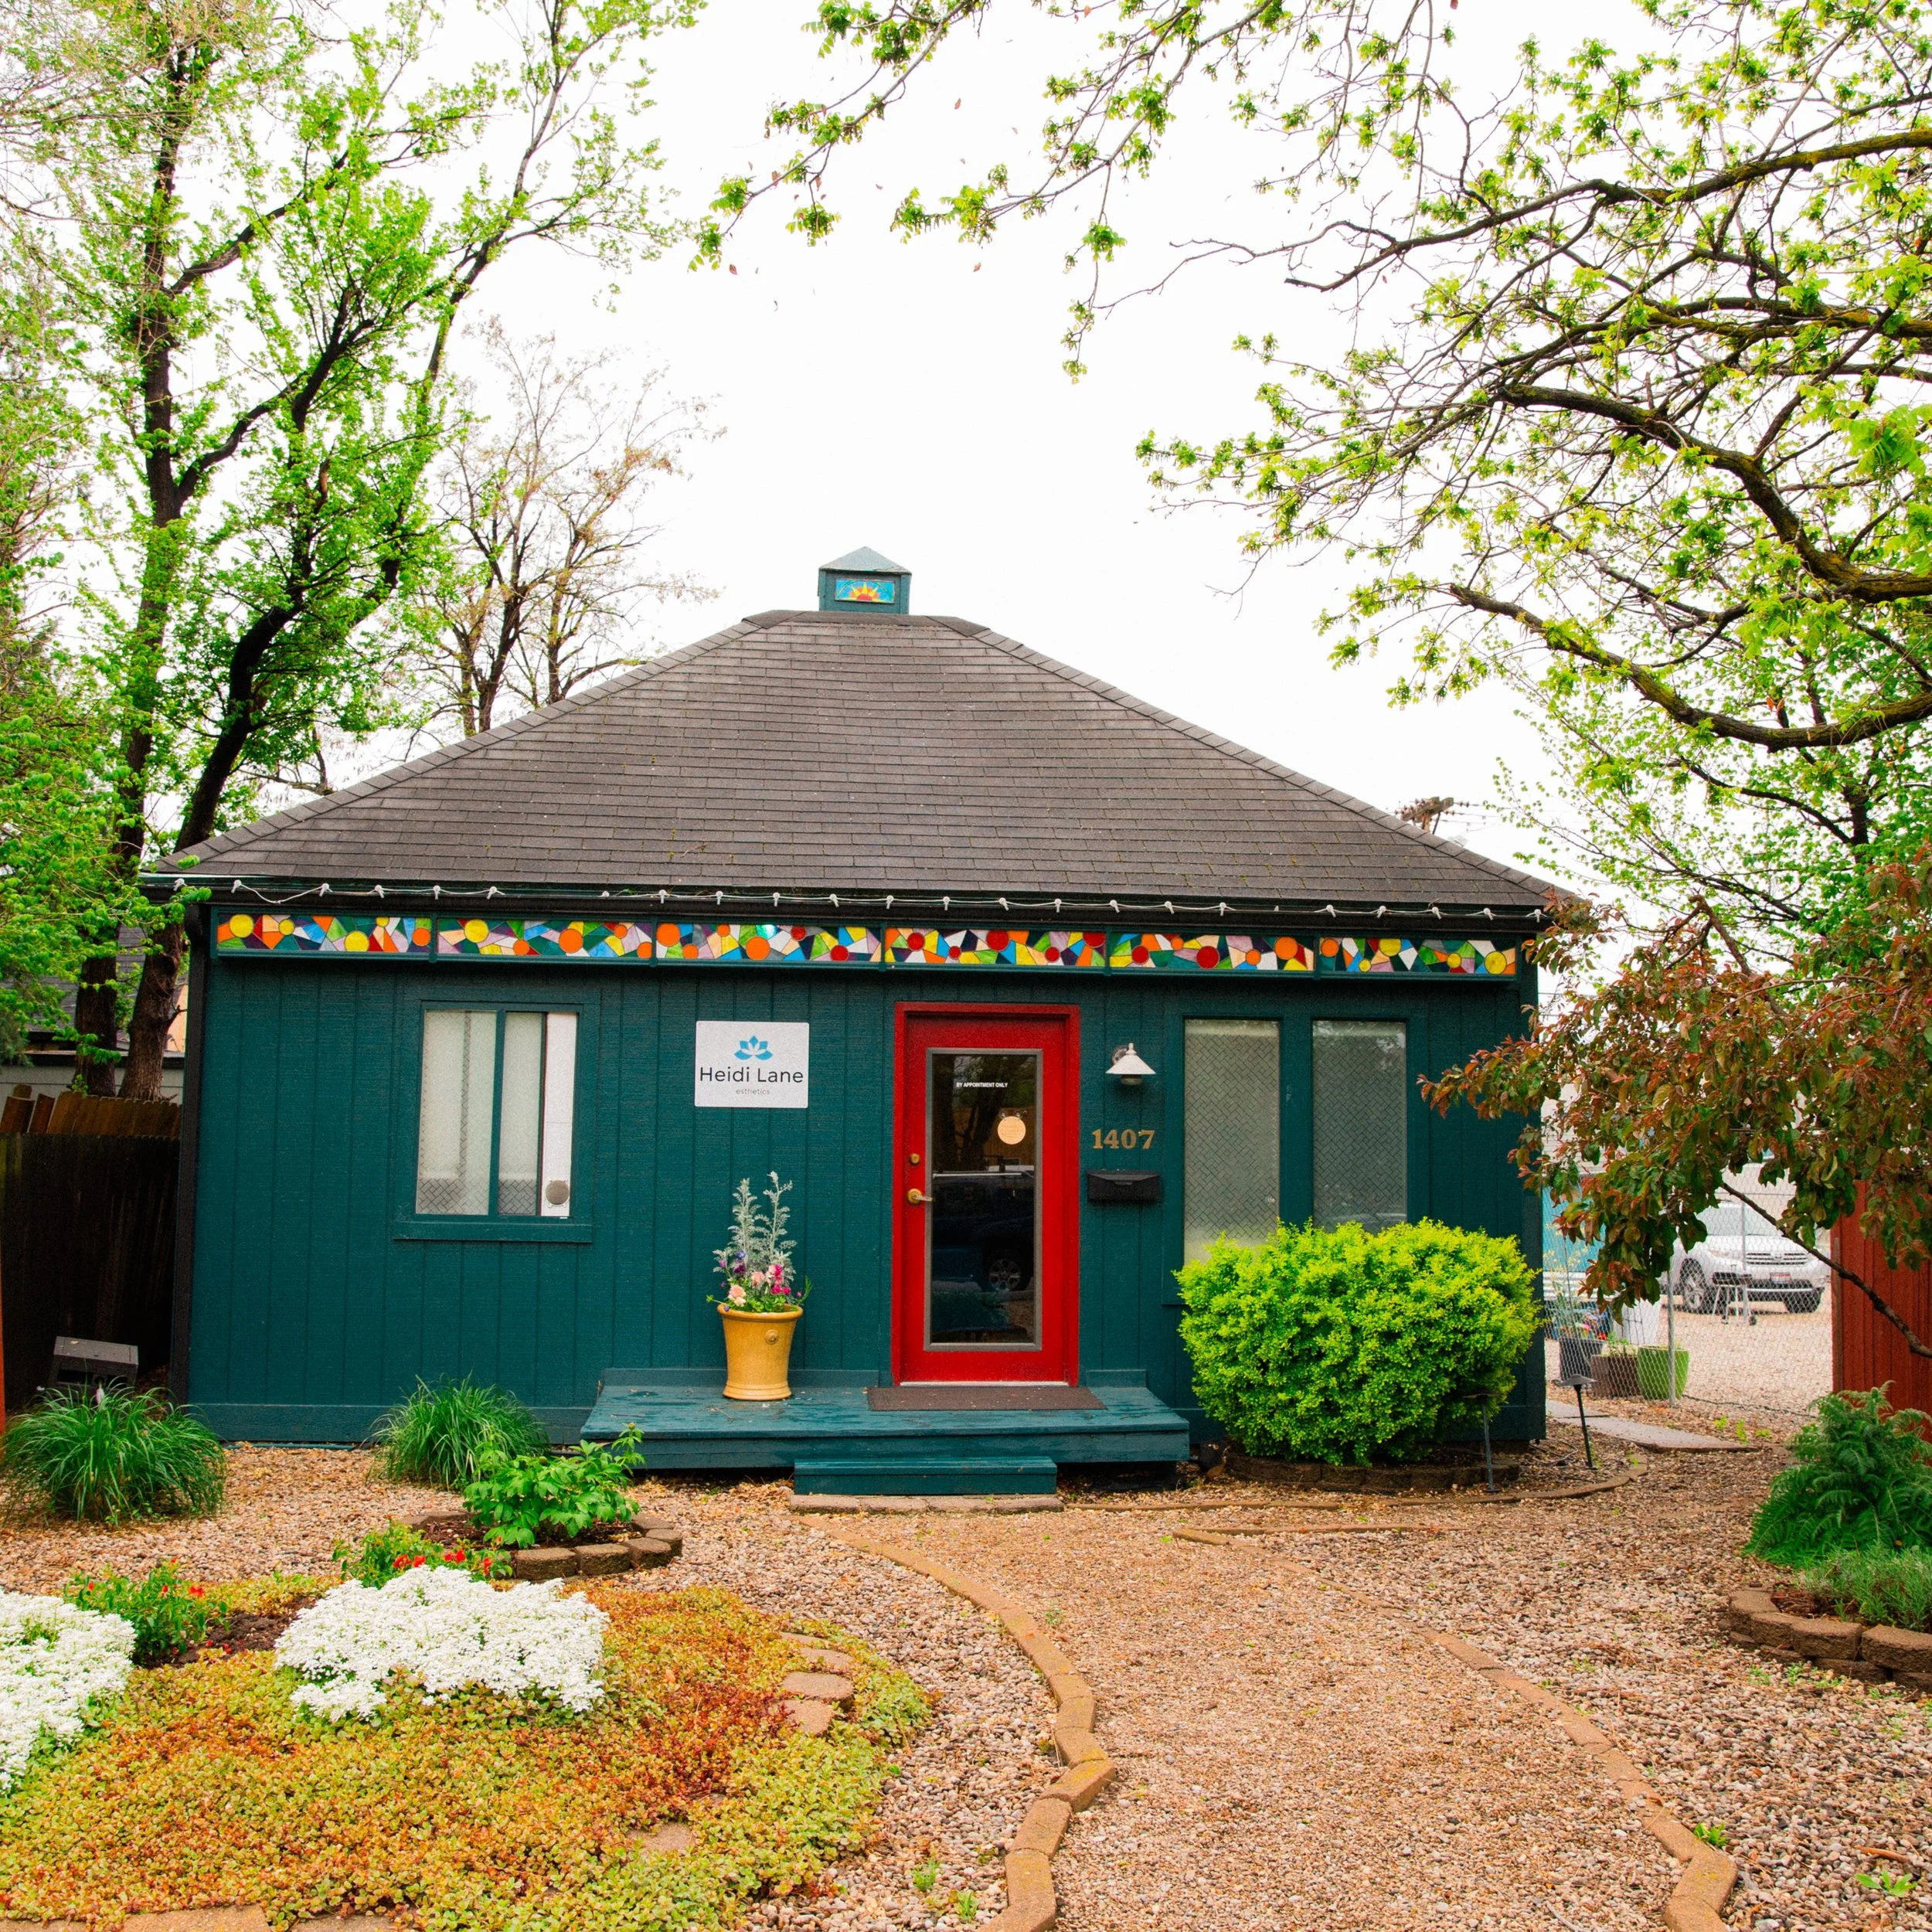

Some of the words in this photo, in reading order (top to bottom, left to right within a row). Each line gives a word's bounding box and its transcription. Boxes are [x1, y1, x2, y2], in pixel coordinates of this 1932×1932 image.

[699, 1066, 750, 1082] Heidi
[757, 1067, 804, 1083] Lane
[1092, 1128, 1155, 1150] 1407
